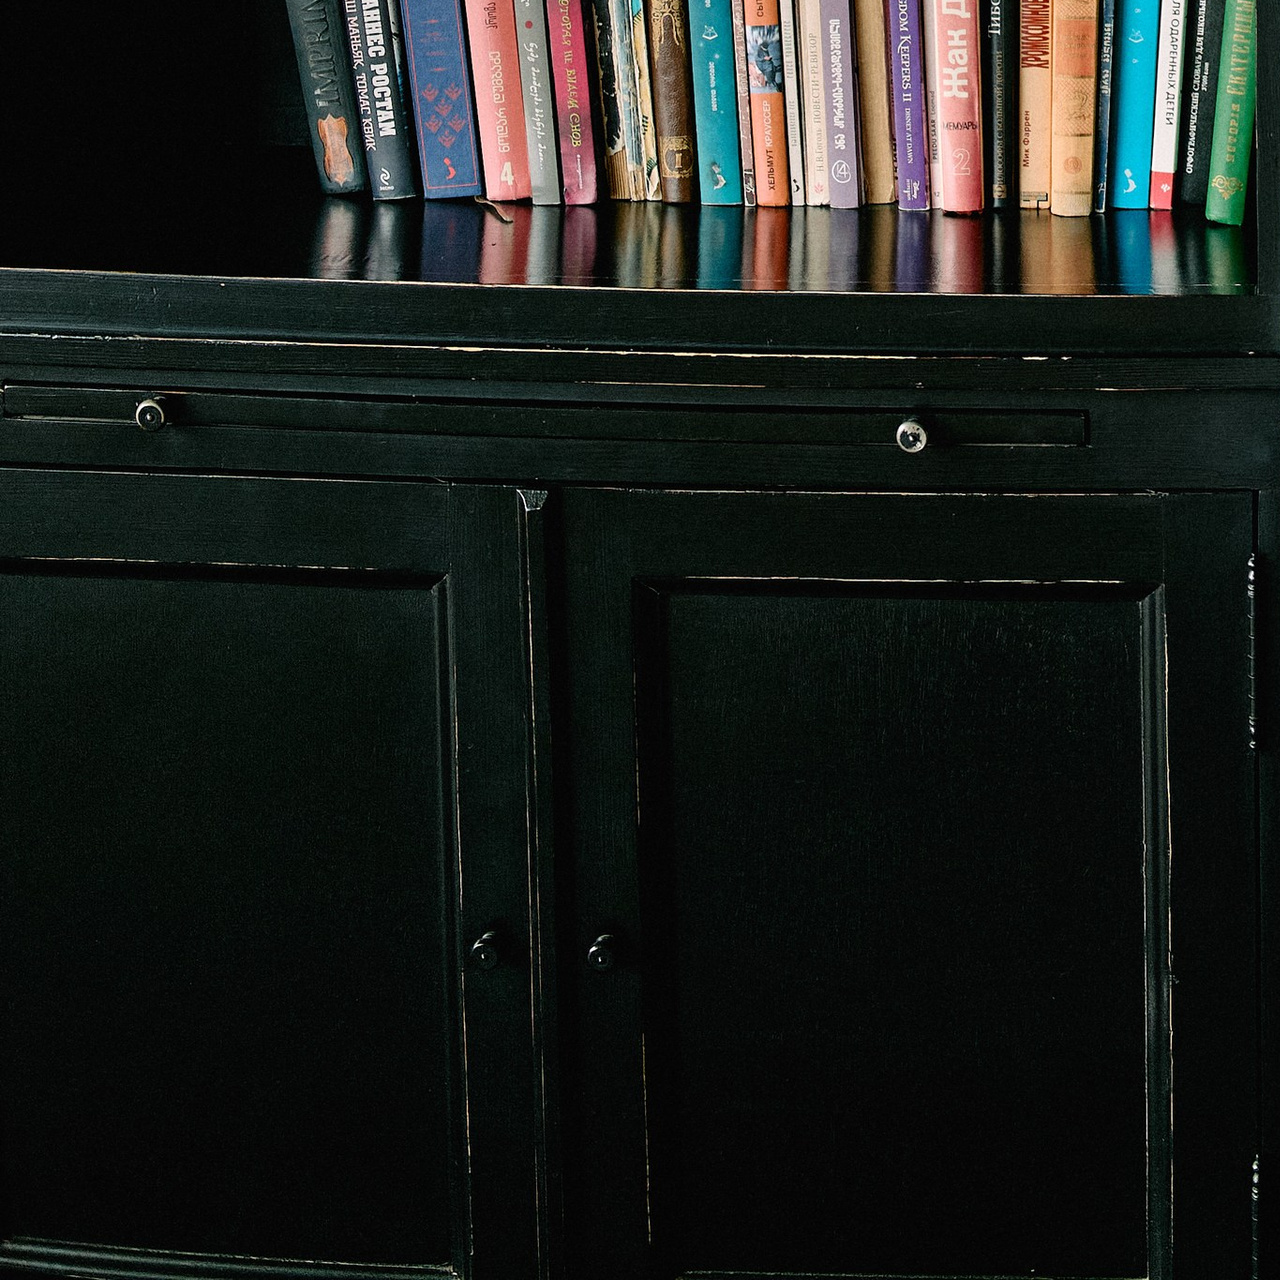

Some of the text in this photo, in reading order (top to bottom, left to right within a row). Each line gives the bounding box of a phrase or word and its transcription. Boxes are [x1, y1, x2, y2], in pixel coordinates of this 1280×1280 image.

[943, 27, 969, 97] Жак
[370, 63, 396, 137] РОСТАМ
[761, 99, 774, 147] КРАУССЕР
[1022, 110, 1031, 145] Фаррен
[765, 149, 776, 190] ХЕЛЬМУТ
[1022, 148, 1030, 167] Мик
